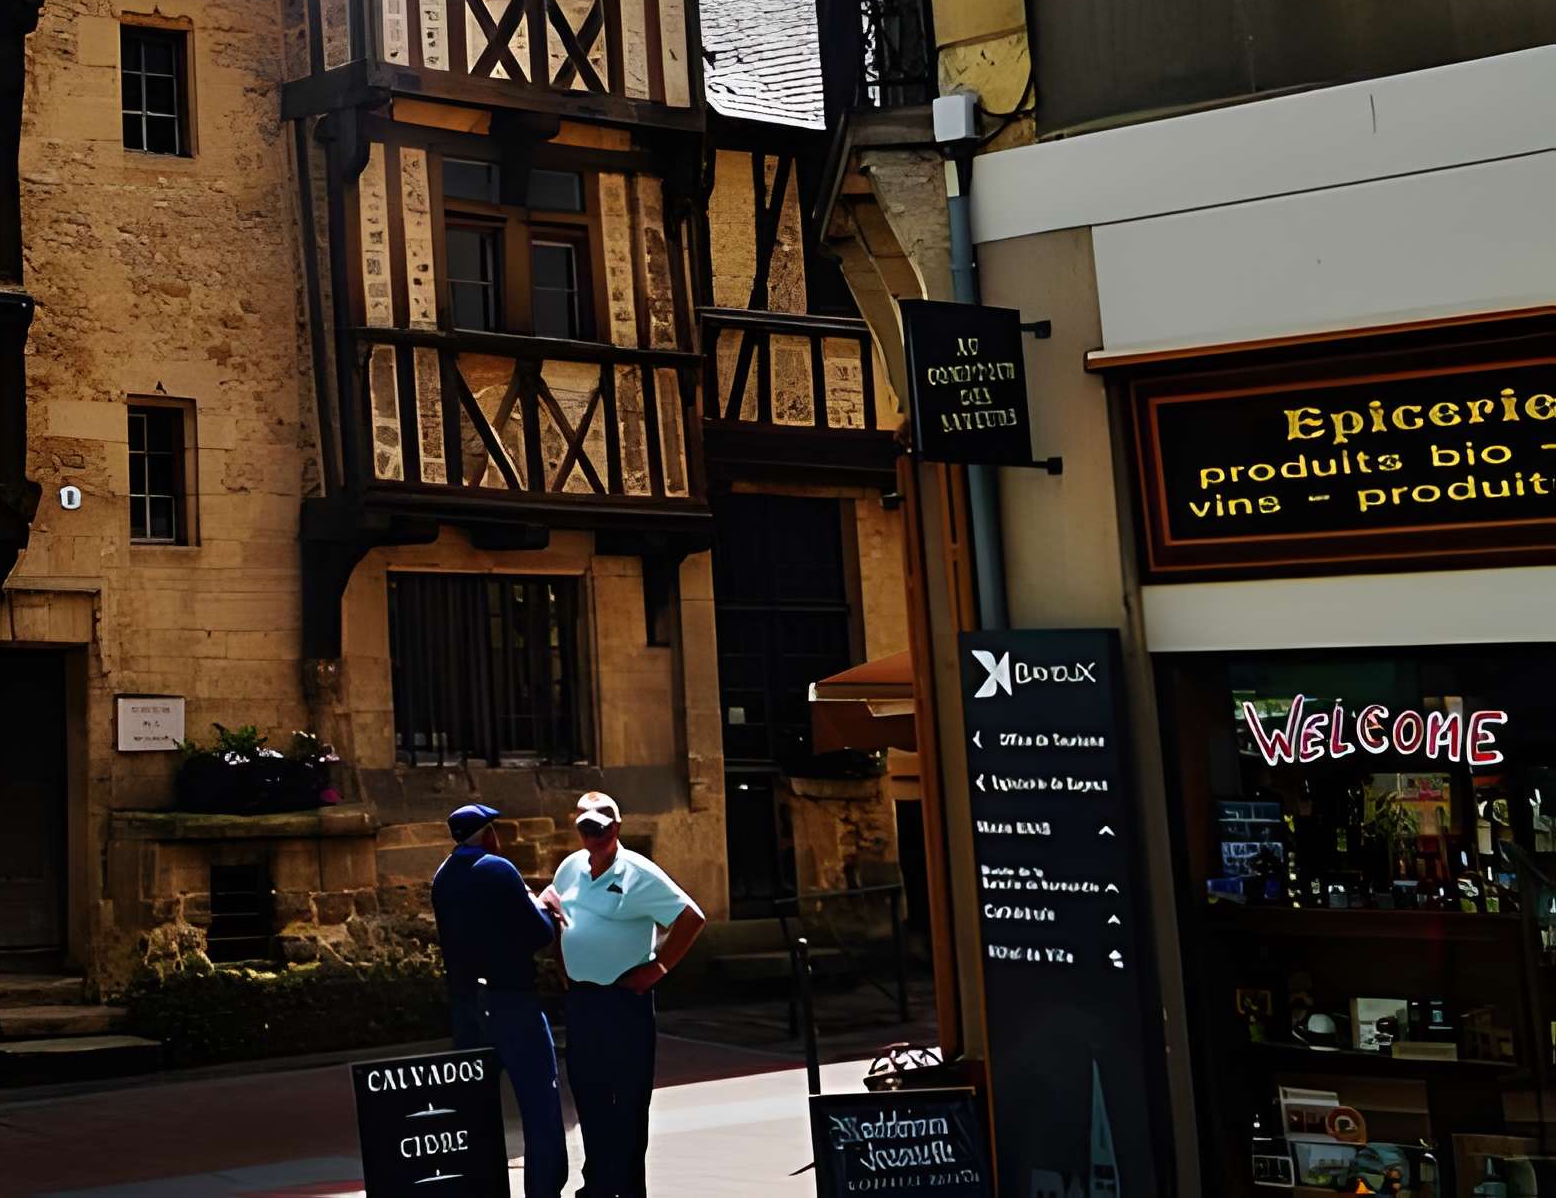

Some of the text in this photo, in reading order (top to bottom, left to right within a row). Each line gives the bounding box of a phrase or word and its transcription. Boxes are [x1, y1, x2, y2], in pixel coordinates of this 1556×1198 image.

[1283, 388, 1556, 445] Epicerie
[1430, 441, 1512, 467] bio
[1357, 471, 1556, 512] produit
[1243, 694, 1508, 765] WELCOME
[368, 1059, 484, 1092] CALVADOS
